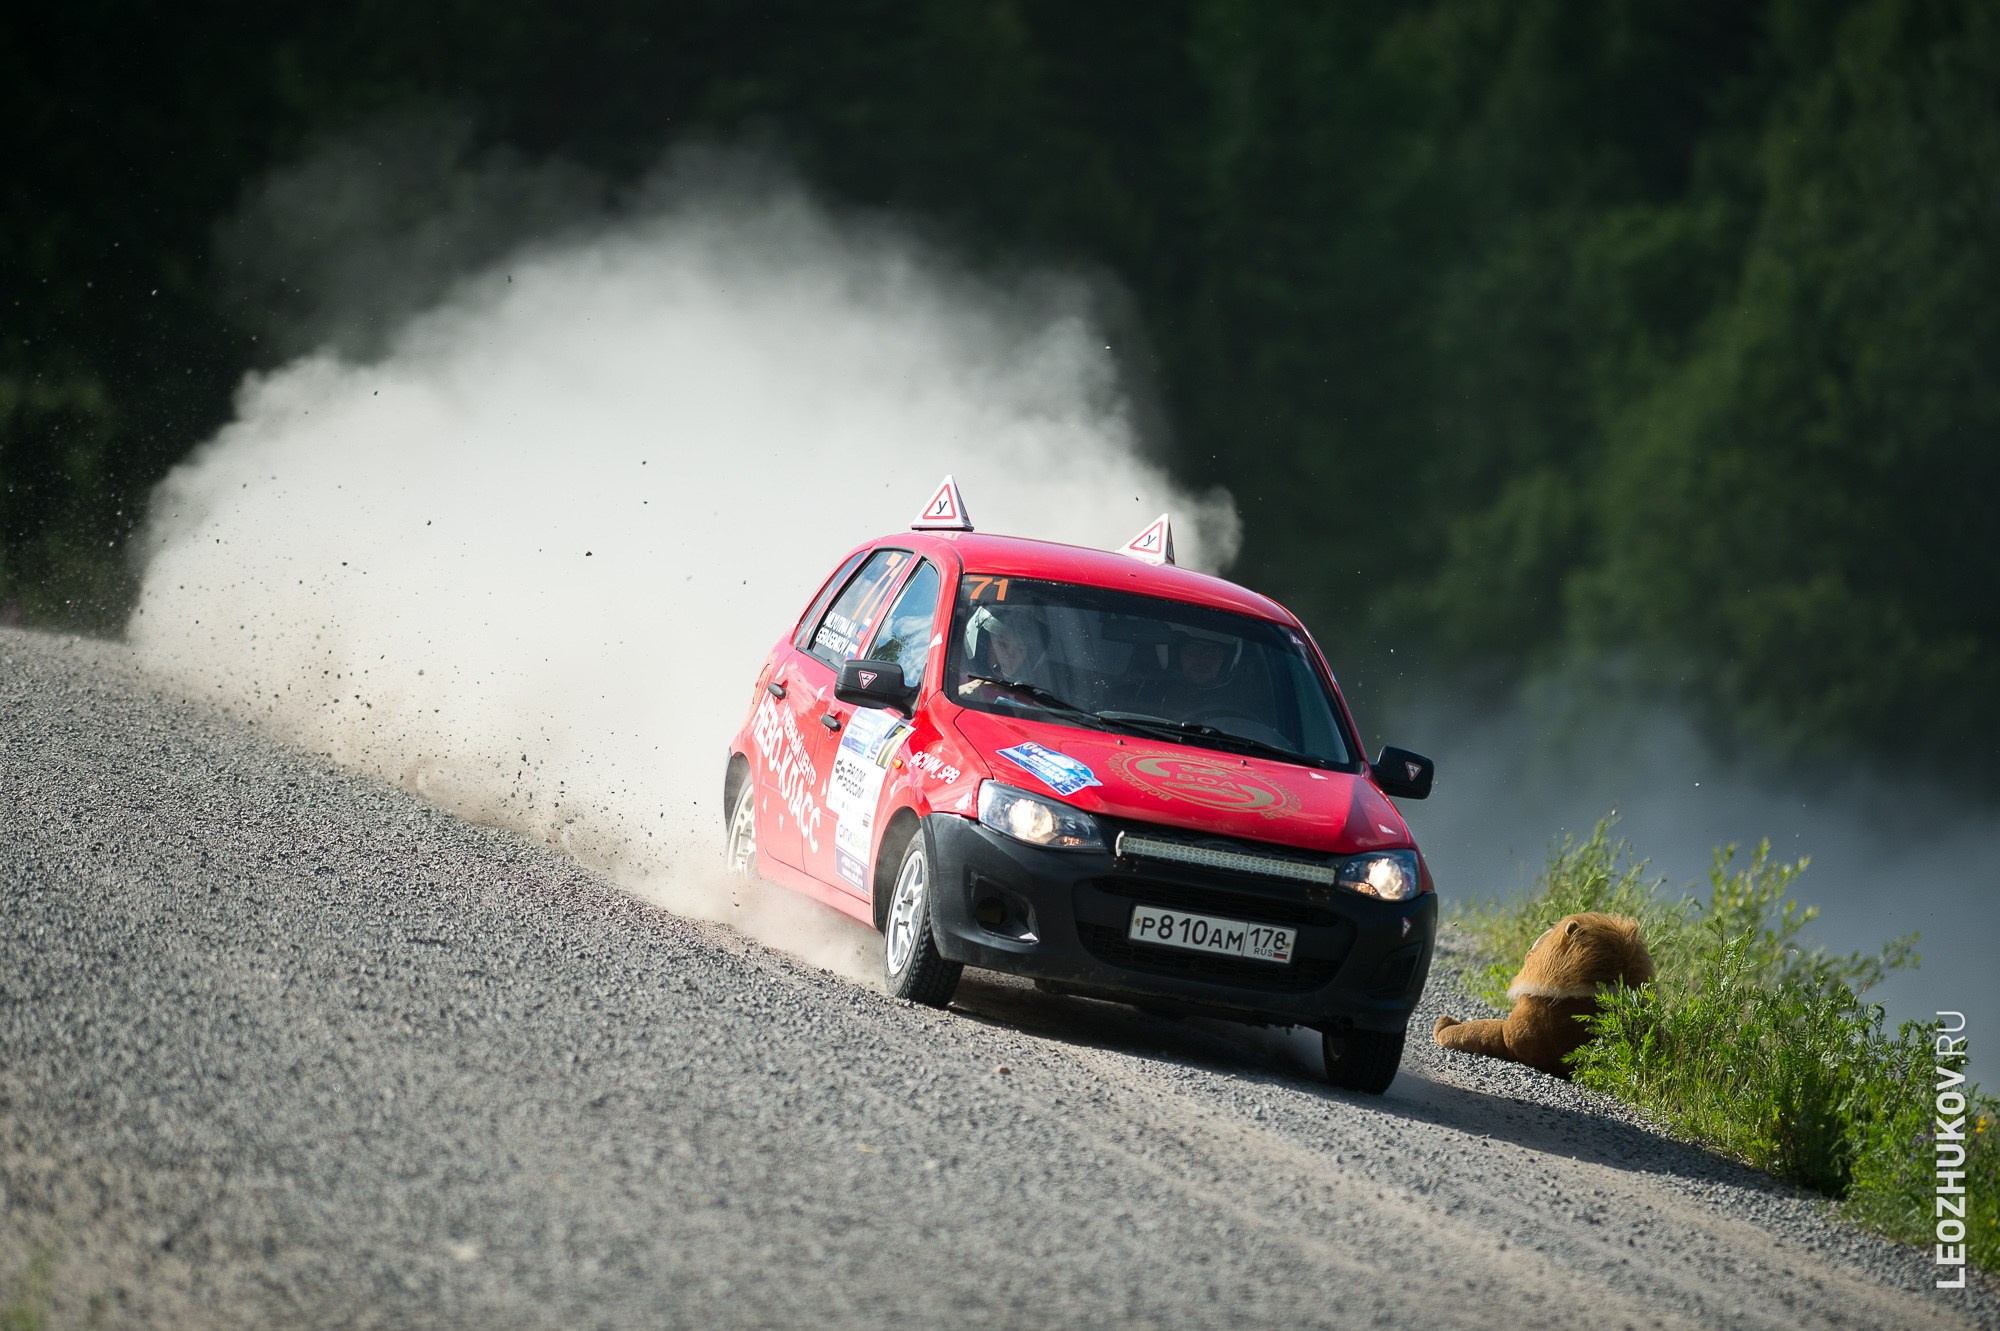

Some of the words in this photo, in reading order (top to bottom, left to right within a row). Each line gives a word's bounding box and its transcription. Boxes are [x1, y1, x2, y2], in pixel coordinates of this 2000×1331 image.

[936, 500, 948, 515] У
[1142, 534, 1157, 547] У
[852, 552, 908, 622] 71
[968, 576, 1009, 602] 71
[751, 687, 821, 853] НЕВО-КЛАСС
[797, 748, 817, 790] ЦЕНТР
[1177, 773, 1237, 789] ВОА
[1140, 914, 1244, 951] Р810АМ
[1250, 927, 1287, 951] 178
[1253, 947, 1273, 957] RUS
